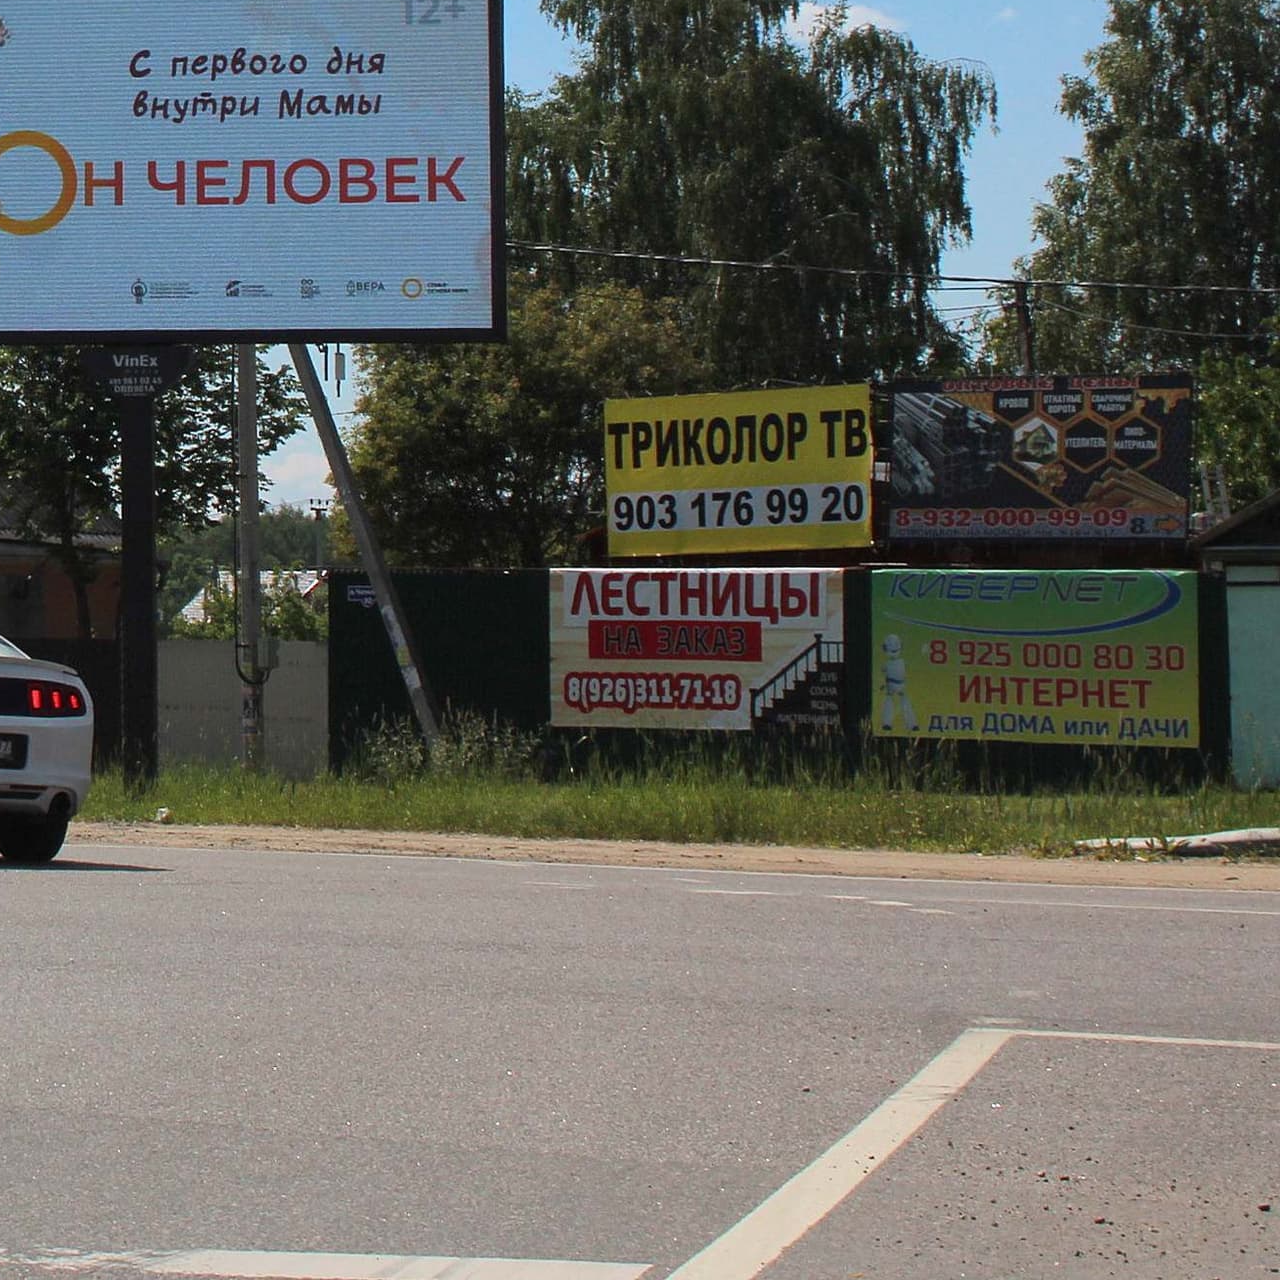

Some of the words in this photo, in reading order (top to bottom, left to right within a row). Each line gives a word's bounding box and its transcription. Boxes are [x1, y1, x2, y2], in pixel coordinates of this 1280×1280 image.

[129, 49, 151, 78] С
[171, 47, 308, 81] первого
[326, 46, 386, 75] дня
[132, 89, 260, 124] внутри
[278, 87, 382, 120] Мамы
[147, 156, 467, 207] ЧЕЛОВЕК
[356, 281, 386, 292] ВЕРА
[112, 354, 159, 368] VinEx
[607, 412, 808, 469] ТРИКОЛОР
[820, 408, 868, 459] ТВ
[613, 494, 678, 532] 903
[690, 490, 755, 528] 176
[766, 487, 809, 525] 99
[821, 484, 865, 523] 20
[895, 508, 1129, 528] 8-932-000-99-09
[570, 571, 820, 624] ЛЕСТНИЦЫ
[602, 625, 642, 655] НА
[655, 626, 747, 657] ЗАКАЗ
[929, 639, 949, 665] 8
[958, 641, 1012, 668] 925
[1022, 642, 1082, 669] 000
[1093, 644, 1135, 671] 80
[1144, 645, 1186, 672] 30
[958, 675, 1153, 709] ИНТЕРНЕТ
[927, 714, 974, 733] для
[981, 712, 1057, 735] ДОМА
[1064, 718, 1110, 736] или
[1117, 717, 1190, 741] ДАЧИ
